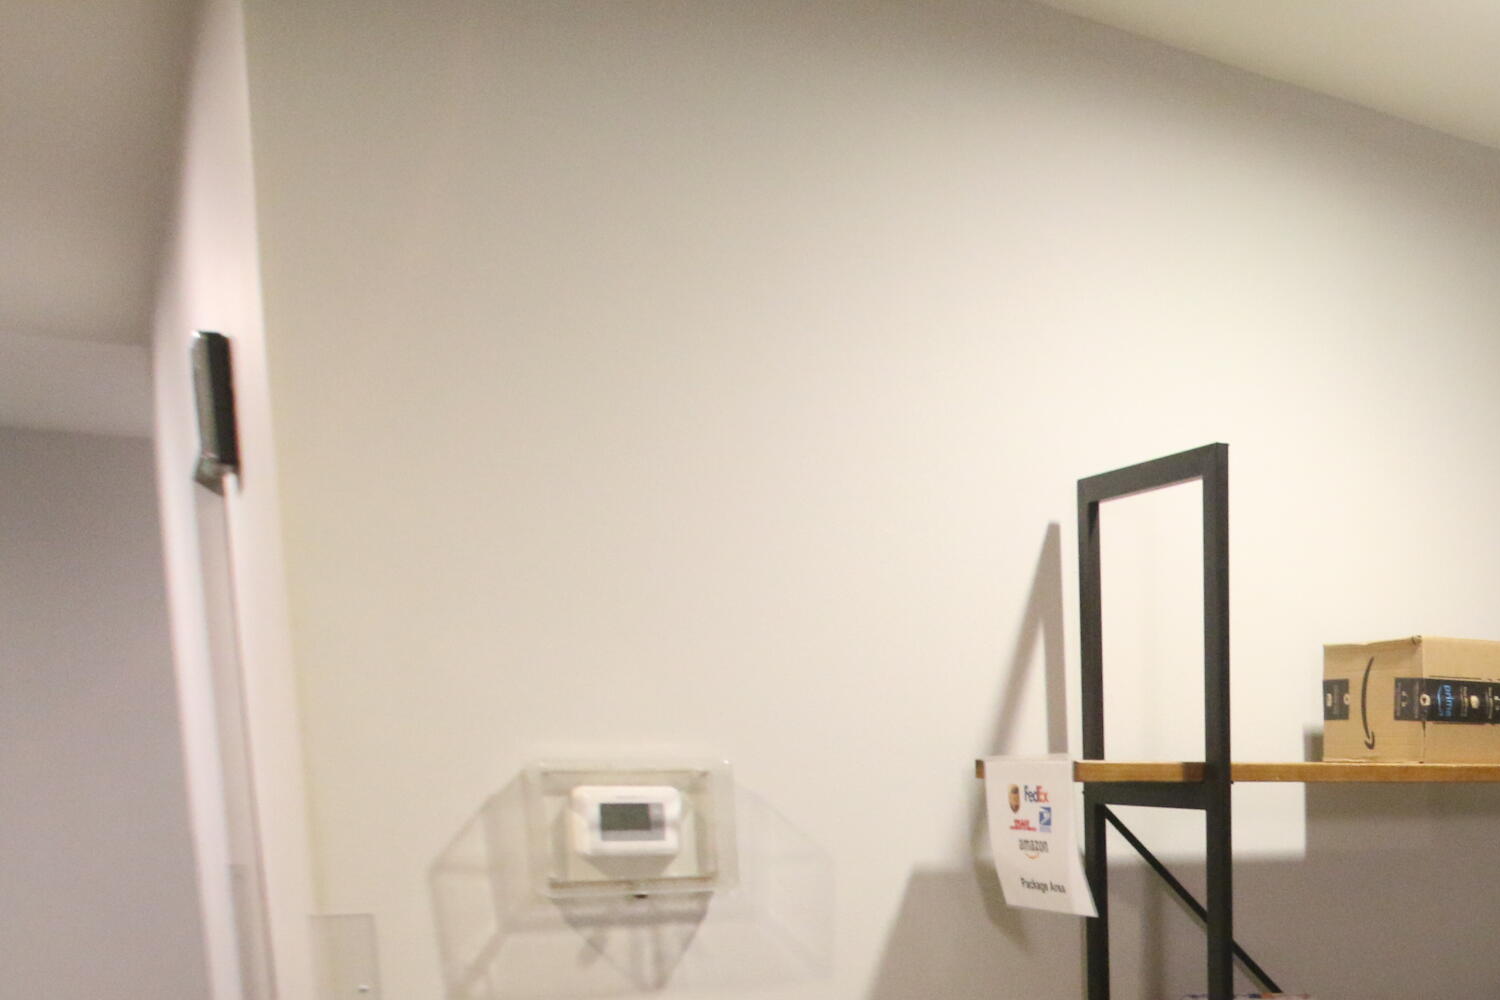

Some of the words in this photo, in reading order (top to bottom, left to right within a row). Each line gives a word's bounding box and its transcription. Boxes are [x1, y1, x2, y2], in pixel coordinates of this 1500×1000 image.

[1443, 684, 1453, 717] prime
[1024, 785, 1049, 802] FedEx
[1020, 877, 1048, 893] Package
[1050, 882, 1066, 893] Area
